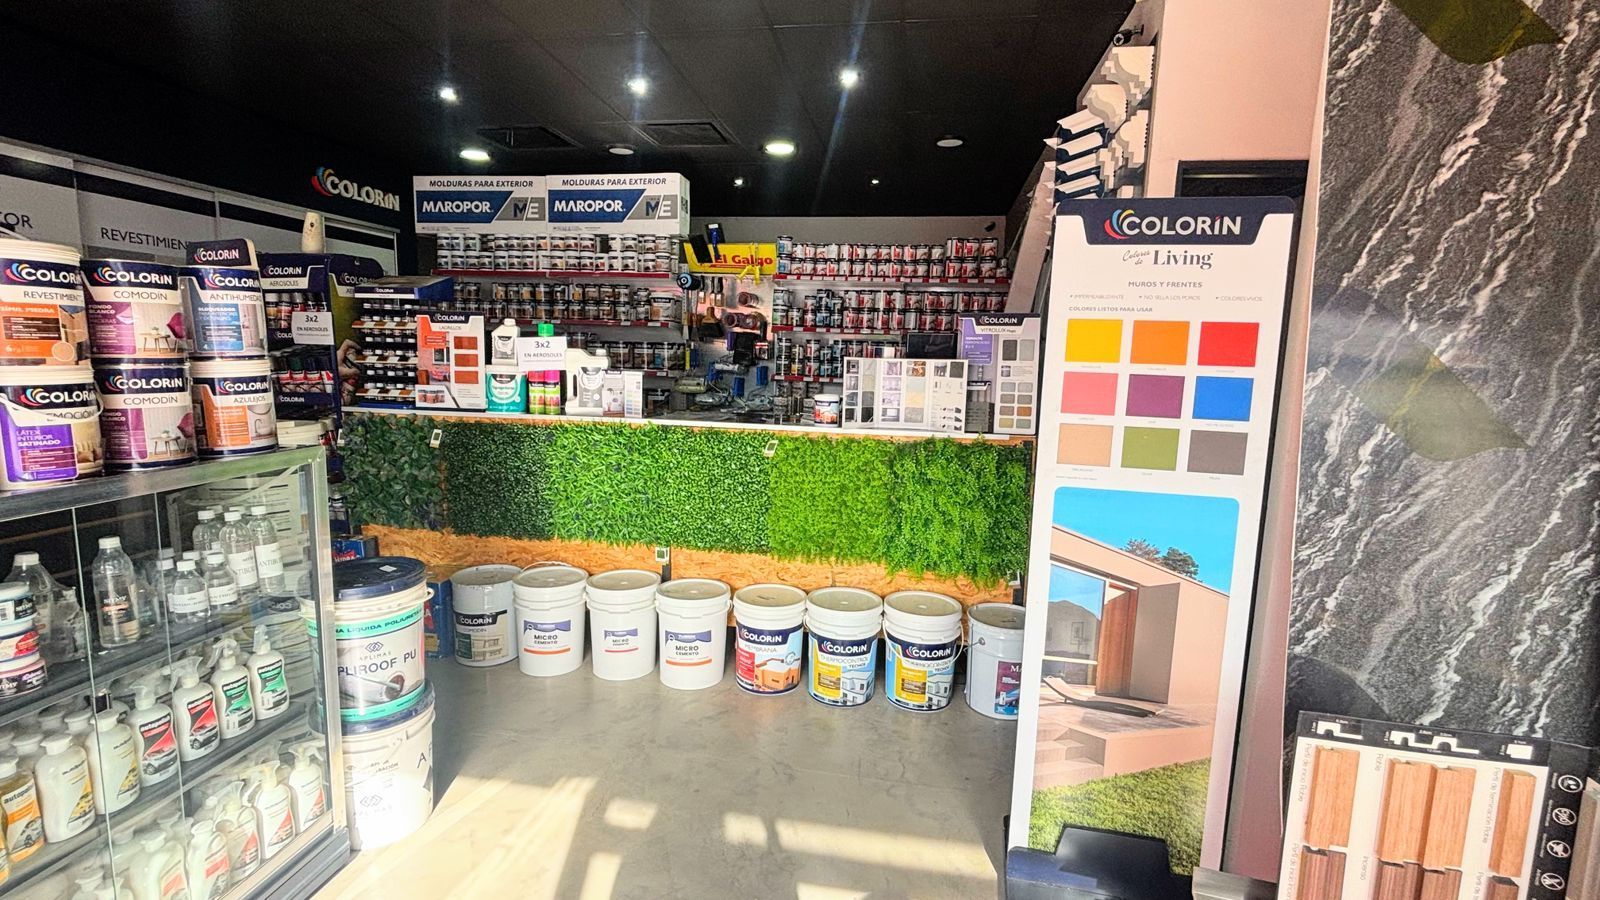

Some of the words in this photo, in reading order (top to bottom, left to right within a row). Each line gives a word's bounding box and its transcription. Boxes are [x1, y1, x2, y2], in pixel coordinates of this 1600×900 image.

[607, 178, 626, 186] PARA
[1153, 250, 1213, 270] Living
[305, 315, 318, 323] 3x2
[534, 341, 550, 349] 3x2
